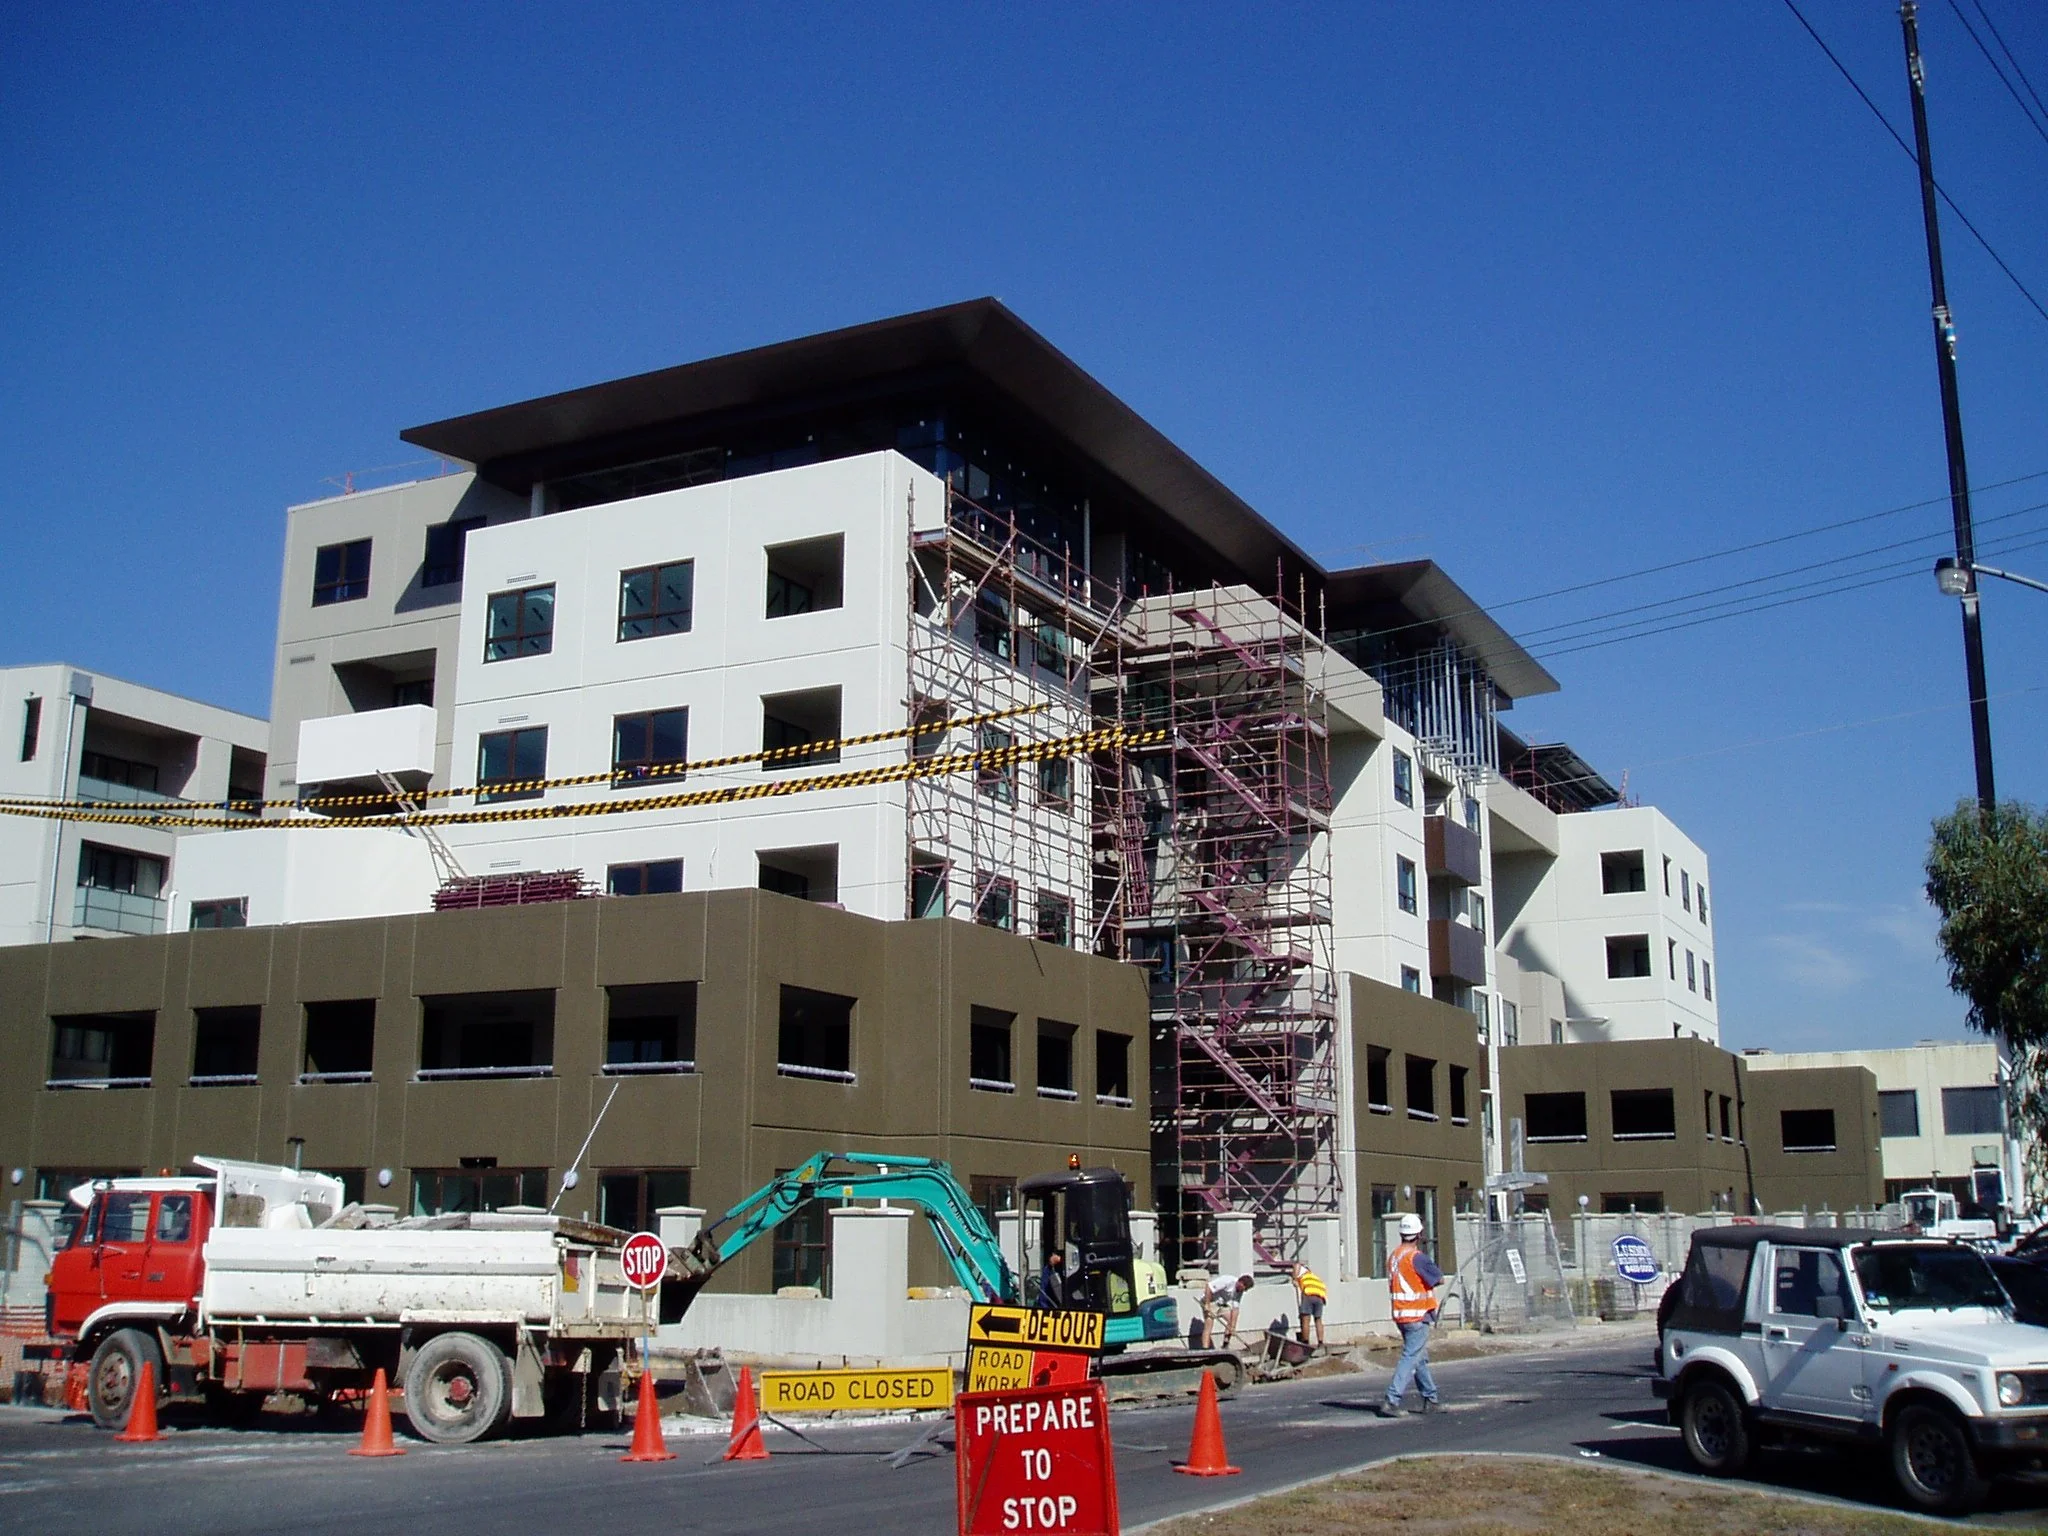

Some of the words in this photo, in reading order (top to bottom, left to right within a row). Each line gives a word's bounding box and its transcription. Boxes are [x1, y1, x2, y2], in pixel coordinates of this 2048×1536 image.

[626, 1245, 661, 1275] STOP
[1027, 1309, 1098, 1345] DETOUR
[978, 1350, 1024, 1370] ROAD
[778, 1381, 835, 1401] ROAD
[848, 1378, 934, 1400] CLOSED
[976, 1374, 1022, 1391] WORK
[976, 1396, 1095, 1436] PREPARE
[1021, 1448, 1051, 1480] TO
[1003, 1495, 1077, 1529] STOP
